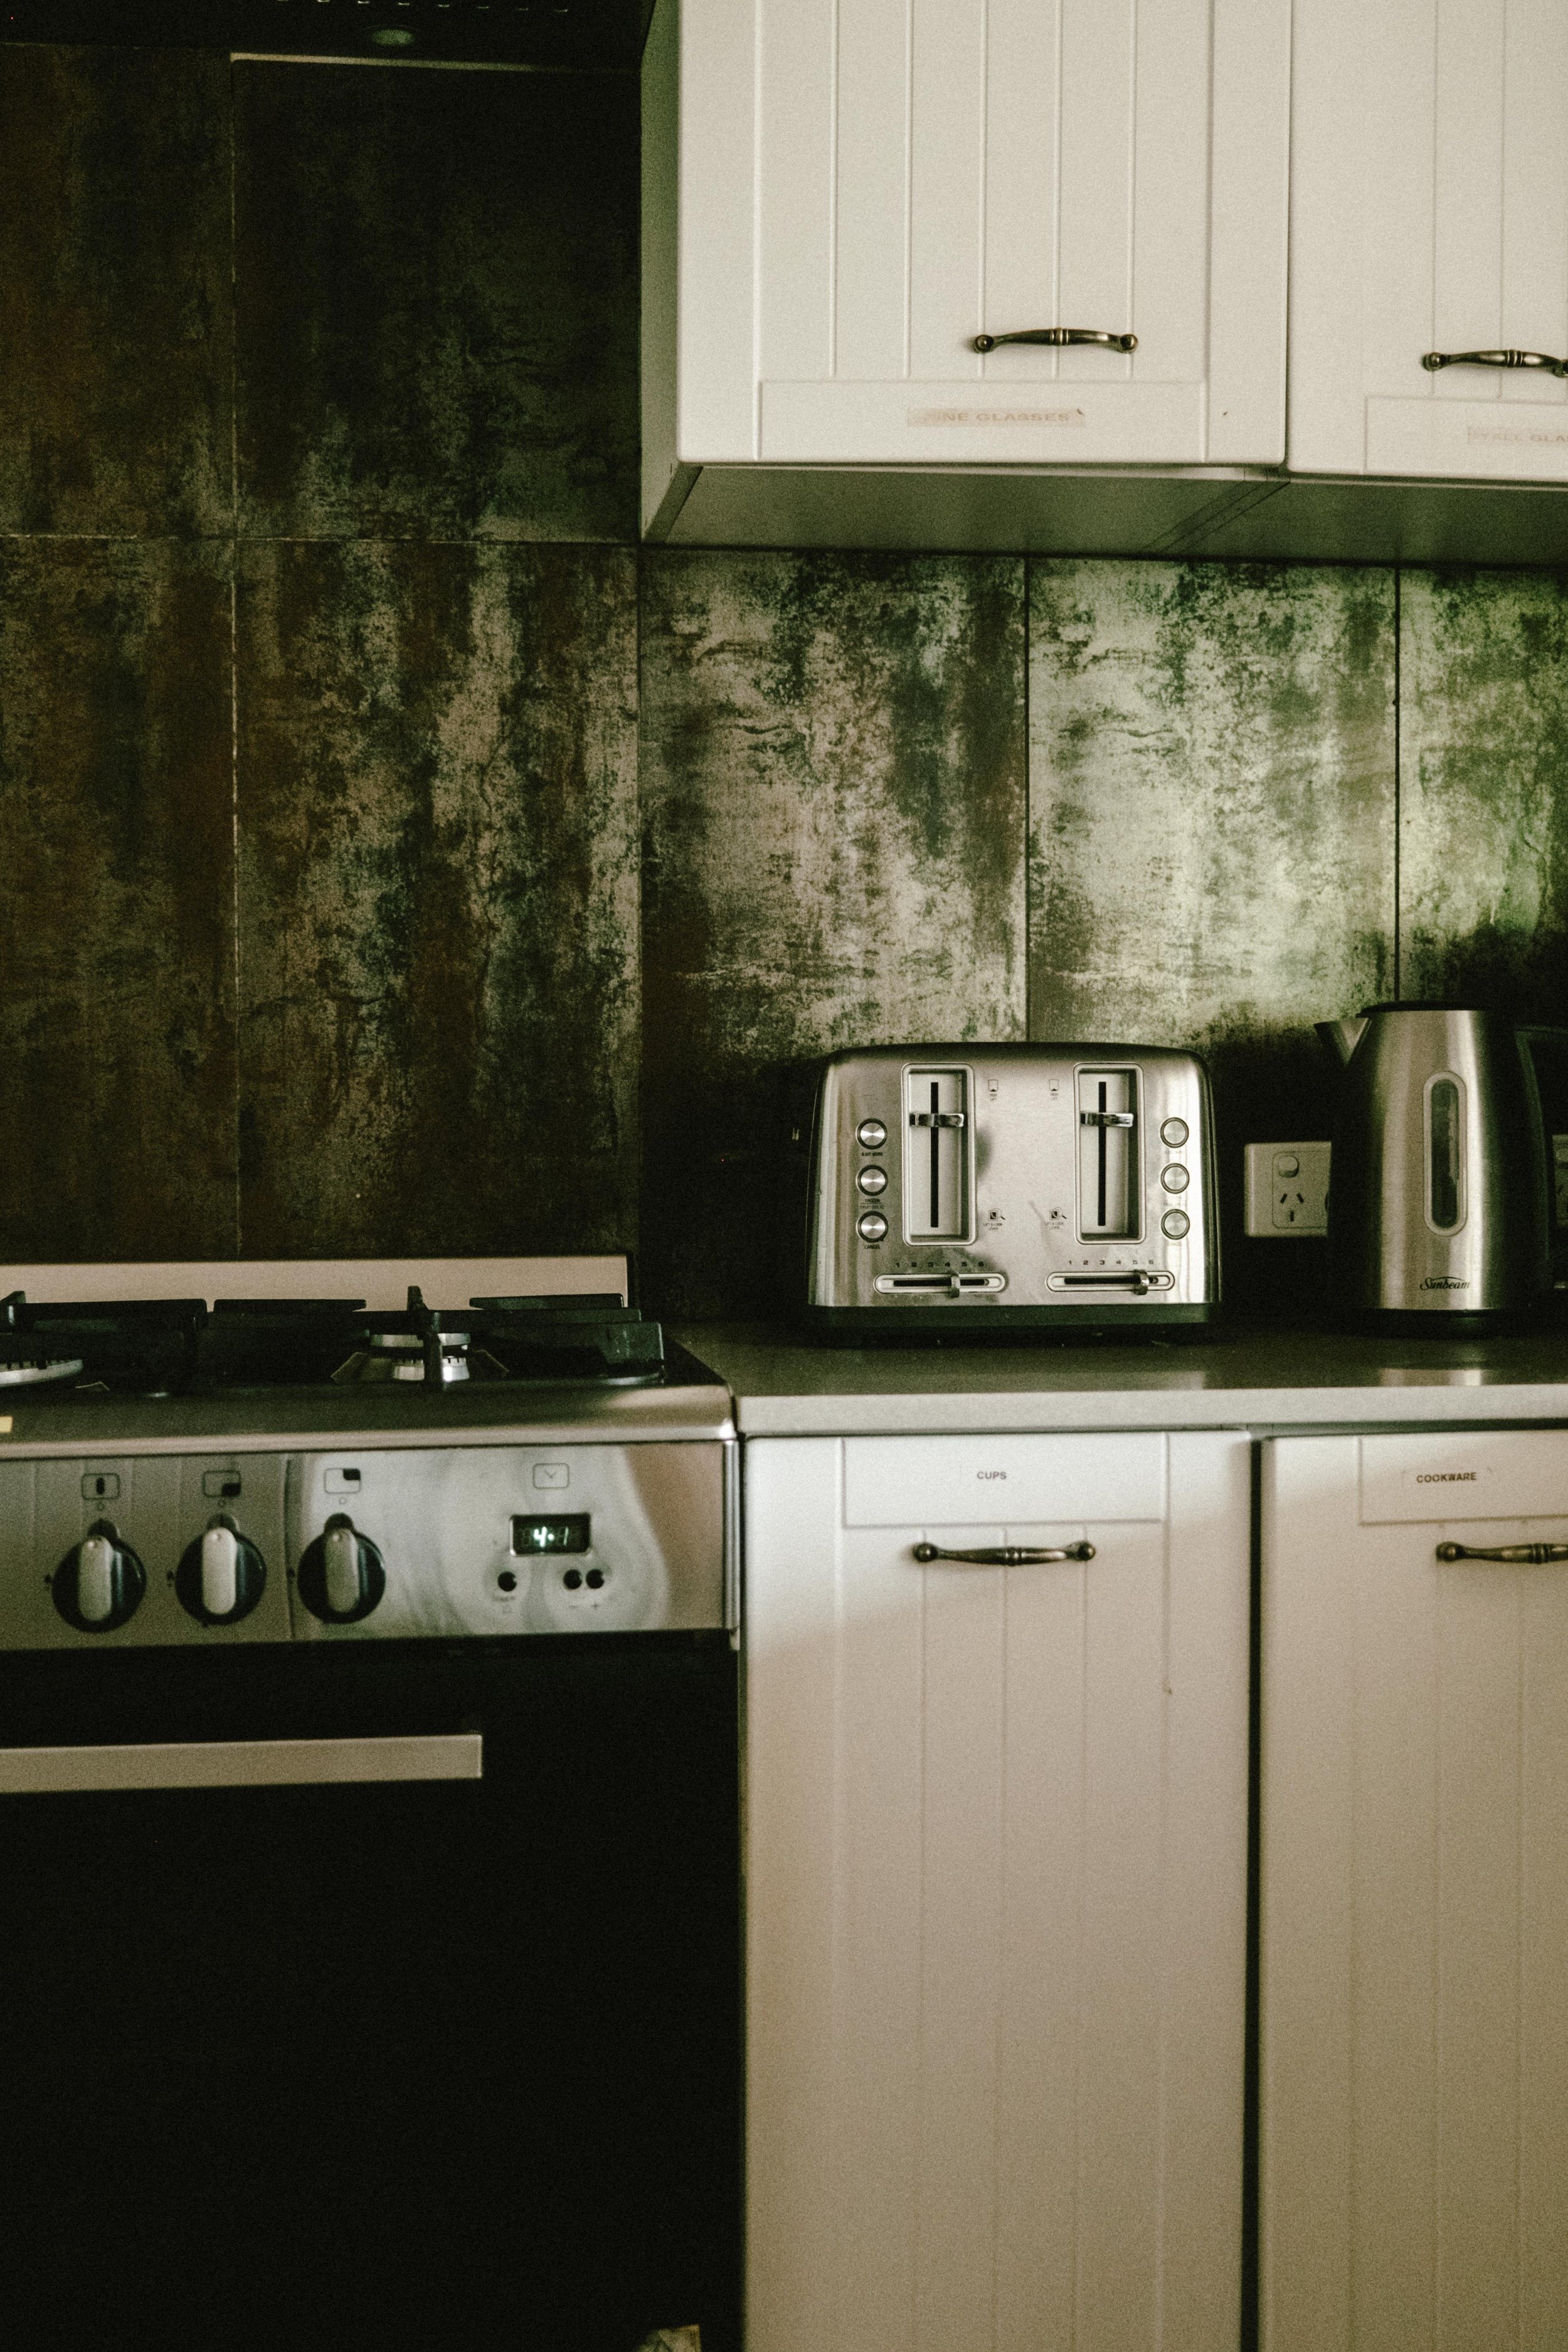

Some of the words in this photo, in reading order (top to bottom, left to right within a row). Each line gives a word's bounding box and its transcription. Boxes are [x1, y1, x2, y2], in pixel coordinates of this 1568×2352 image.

[976, 413, 1068, 421] GLASSES
[1529, 433, 1568, 443] GLA
[1419, 1276, 1470, 1291] Sunbeam
[977, 1471, 1007, 1480] CUPS
[1416, 1471, 1477, 1483] COOKWARE
